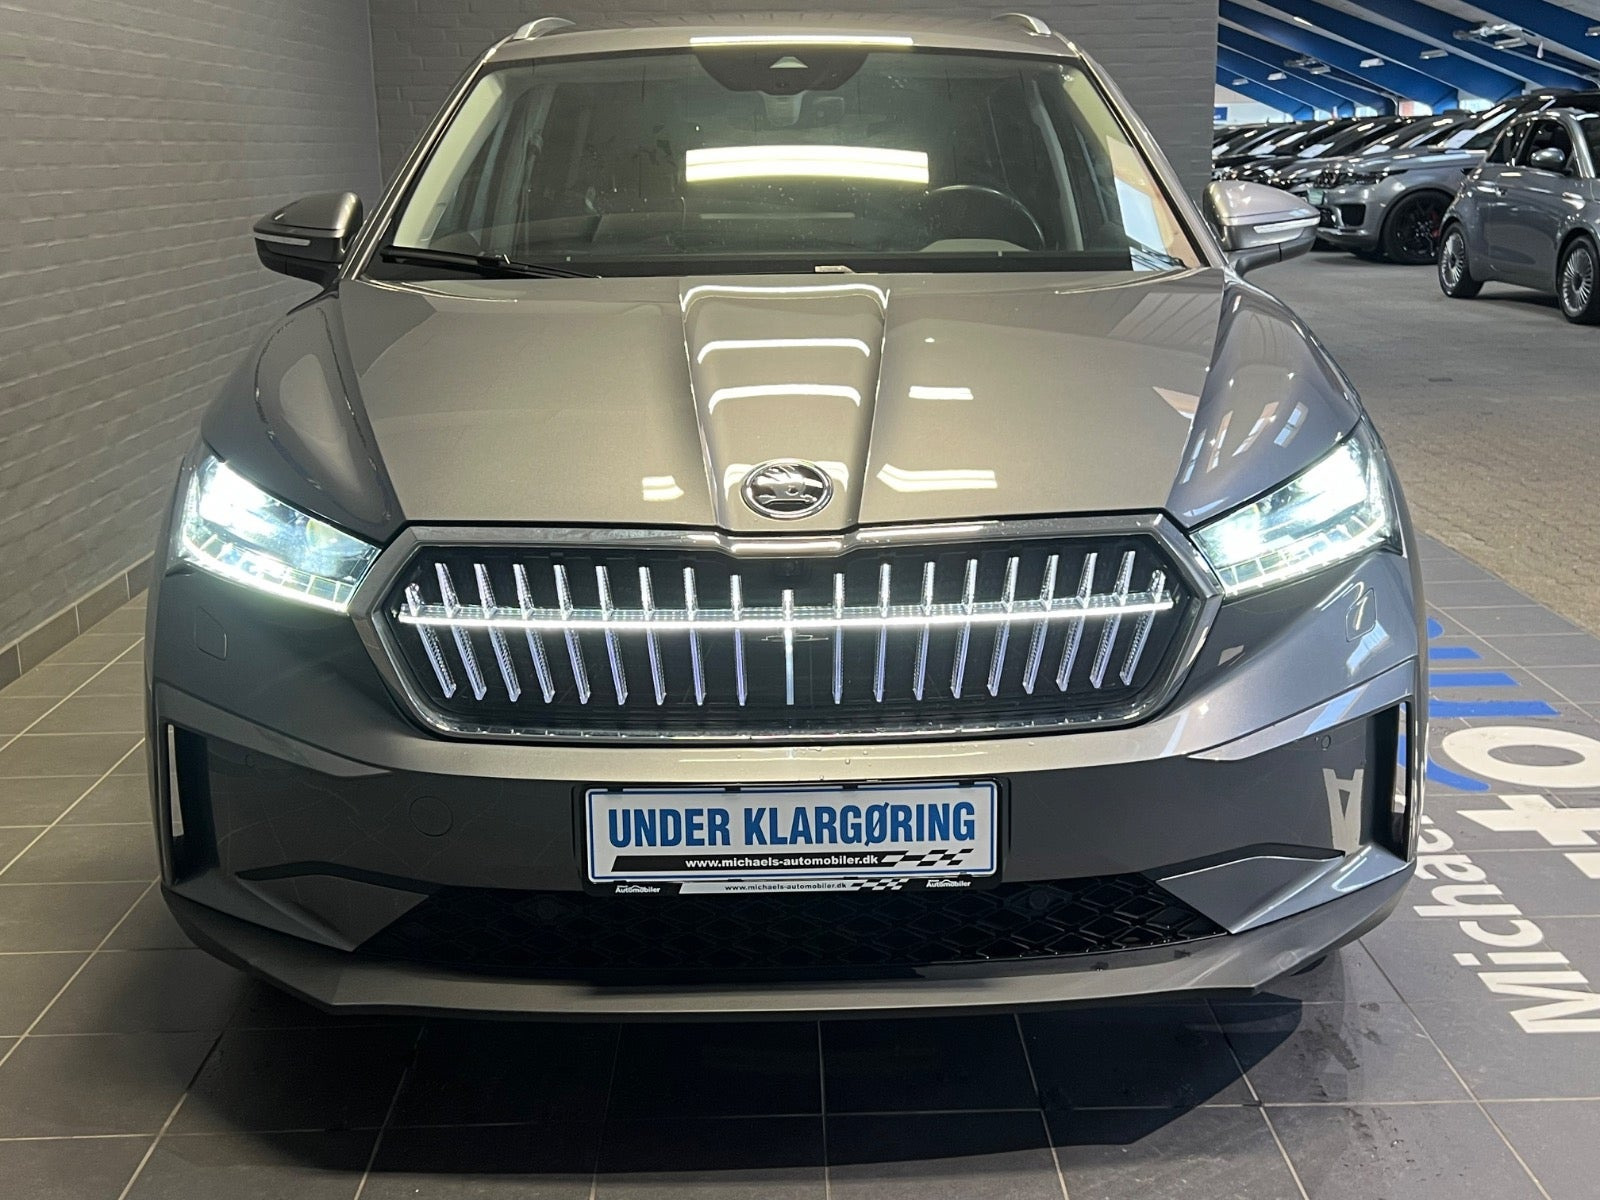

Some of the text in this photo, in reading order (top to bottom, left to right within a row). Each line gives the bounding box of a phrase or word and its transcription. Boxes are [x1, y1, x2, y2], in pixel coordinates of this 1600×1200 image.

[608, 802, 976, 848] UNDER KLARGØRING
[685, 855, 879, 868] www.michaels-automobiler.dk
[724, 882, 847, 891] www.michaels-automobiler.dk
